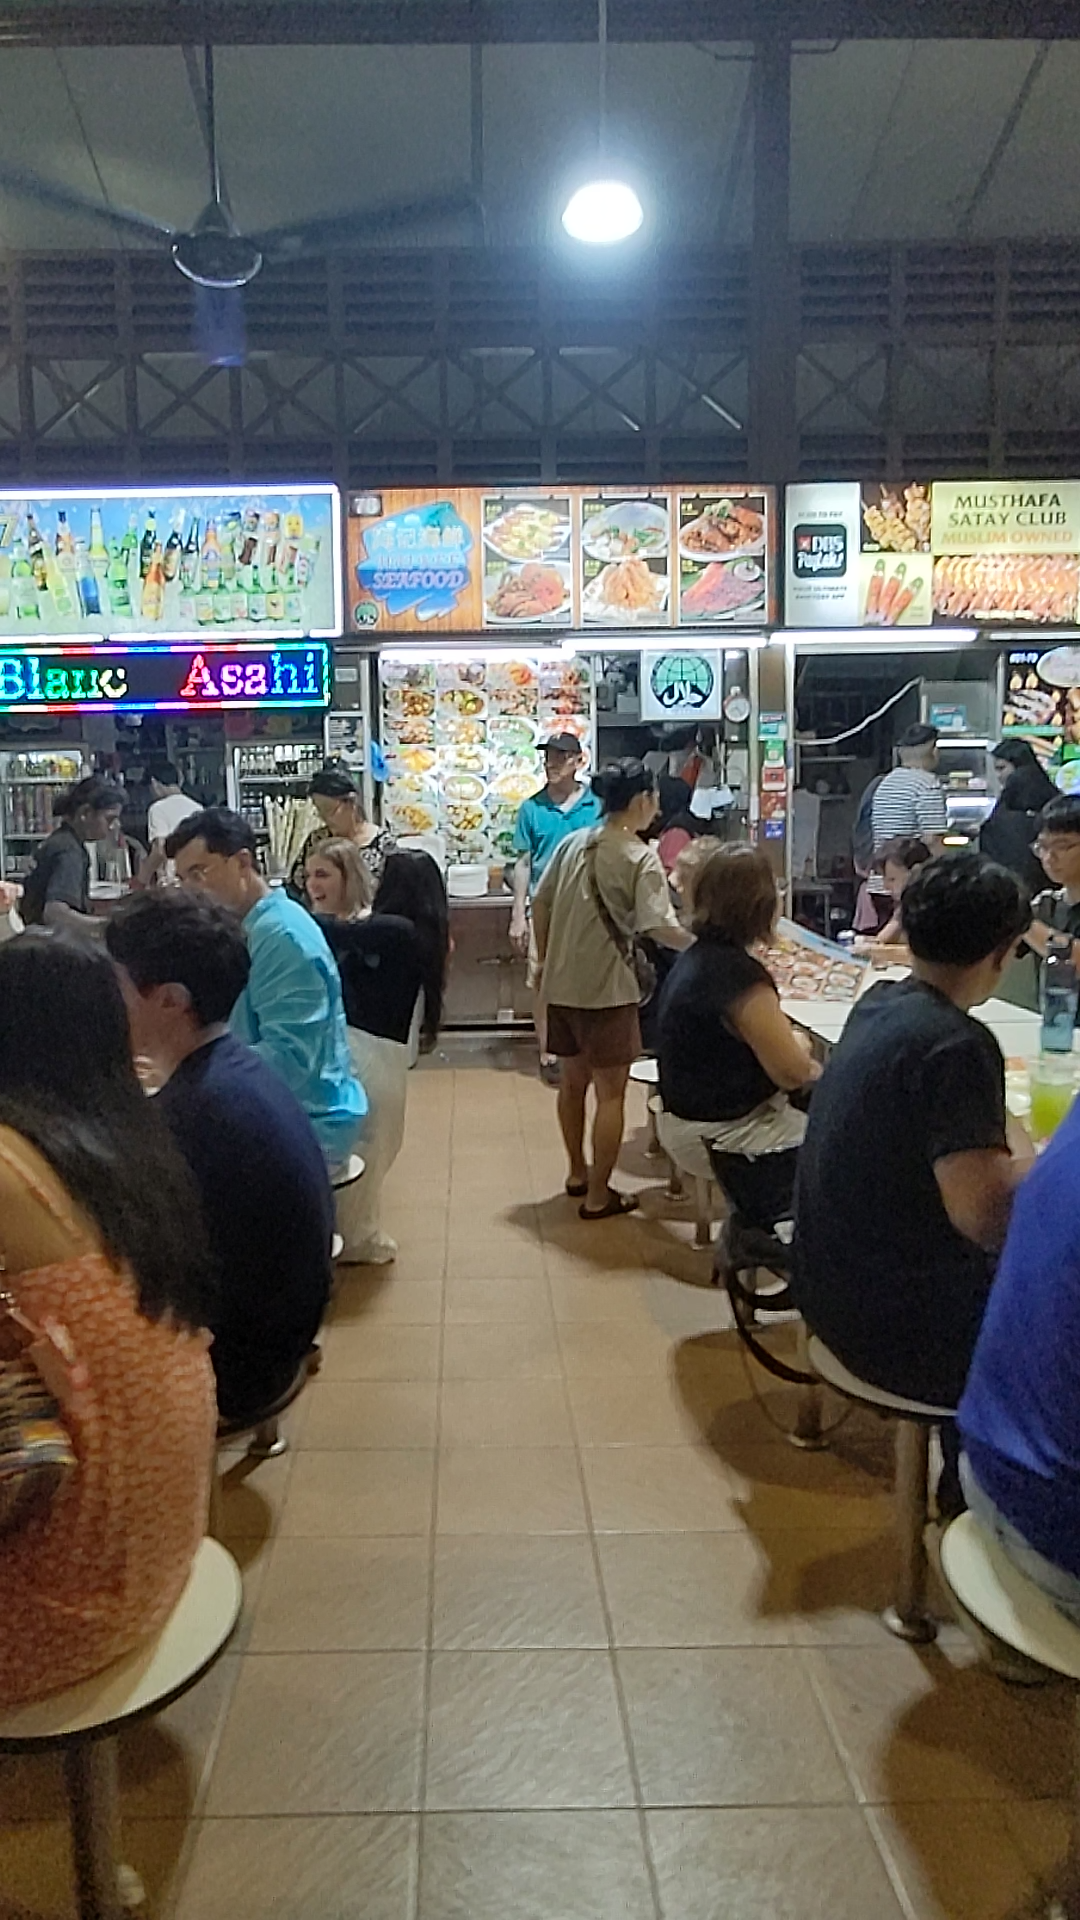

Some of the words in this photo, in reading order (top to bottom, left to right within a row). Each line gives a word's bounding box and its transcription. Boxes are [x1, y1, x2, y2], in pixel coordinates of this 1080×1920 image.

[954, 492, 1062, 509] MUSTHAFA
[948, 512, 1010, 528] SATAY
[1016, 511, 1066, 526] CLUB
[942, 530, 1007, 544] MUSLIM
[1012, 530, 1072, 543] OWNED
[372, 571, 464, 589] SEAFOOD
[0, 656, 128, 699] Blanc
[180, 651, 319, 697] Asahi
